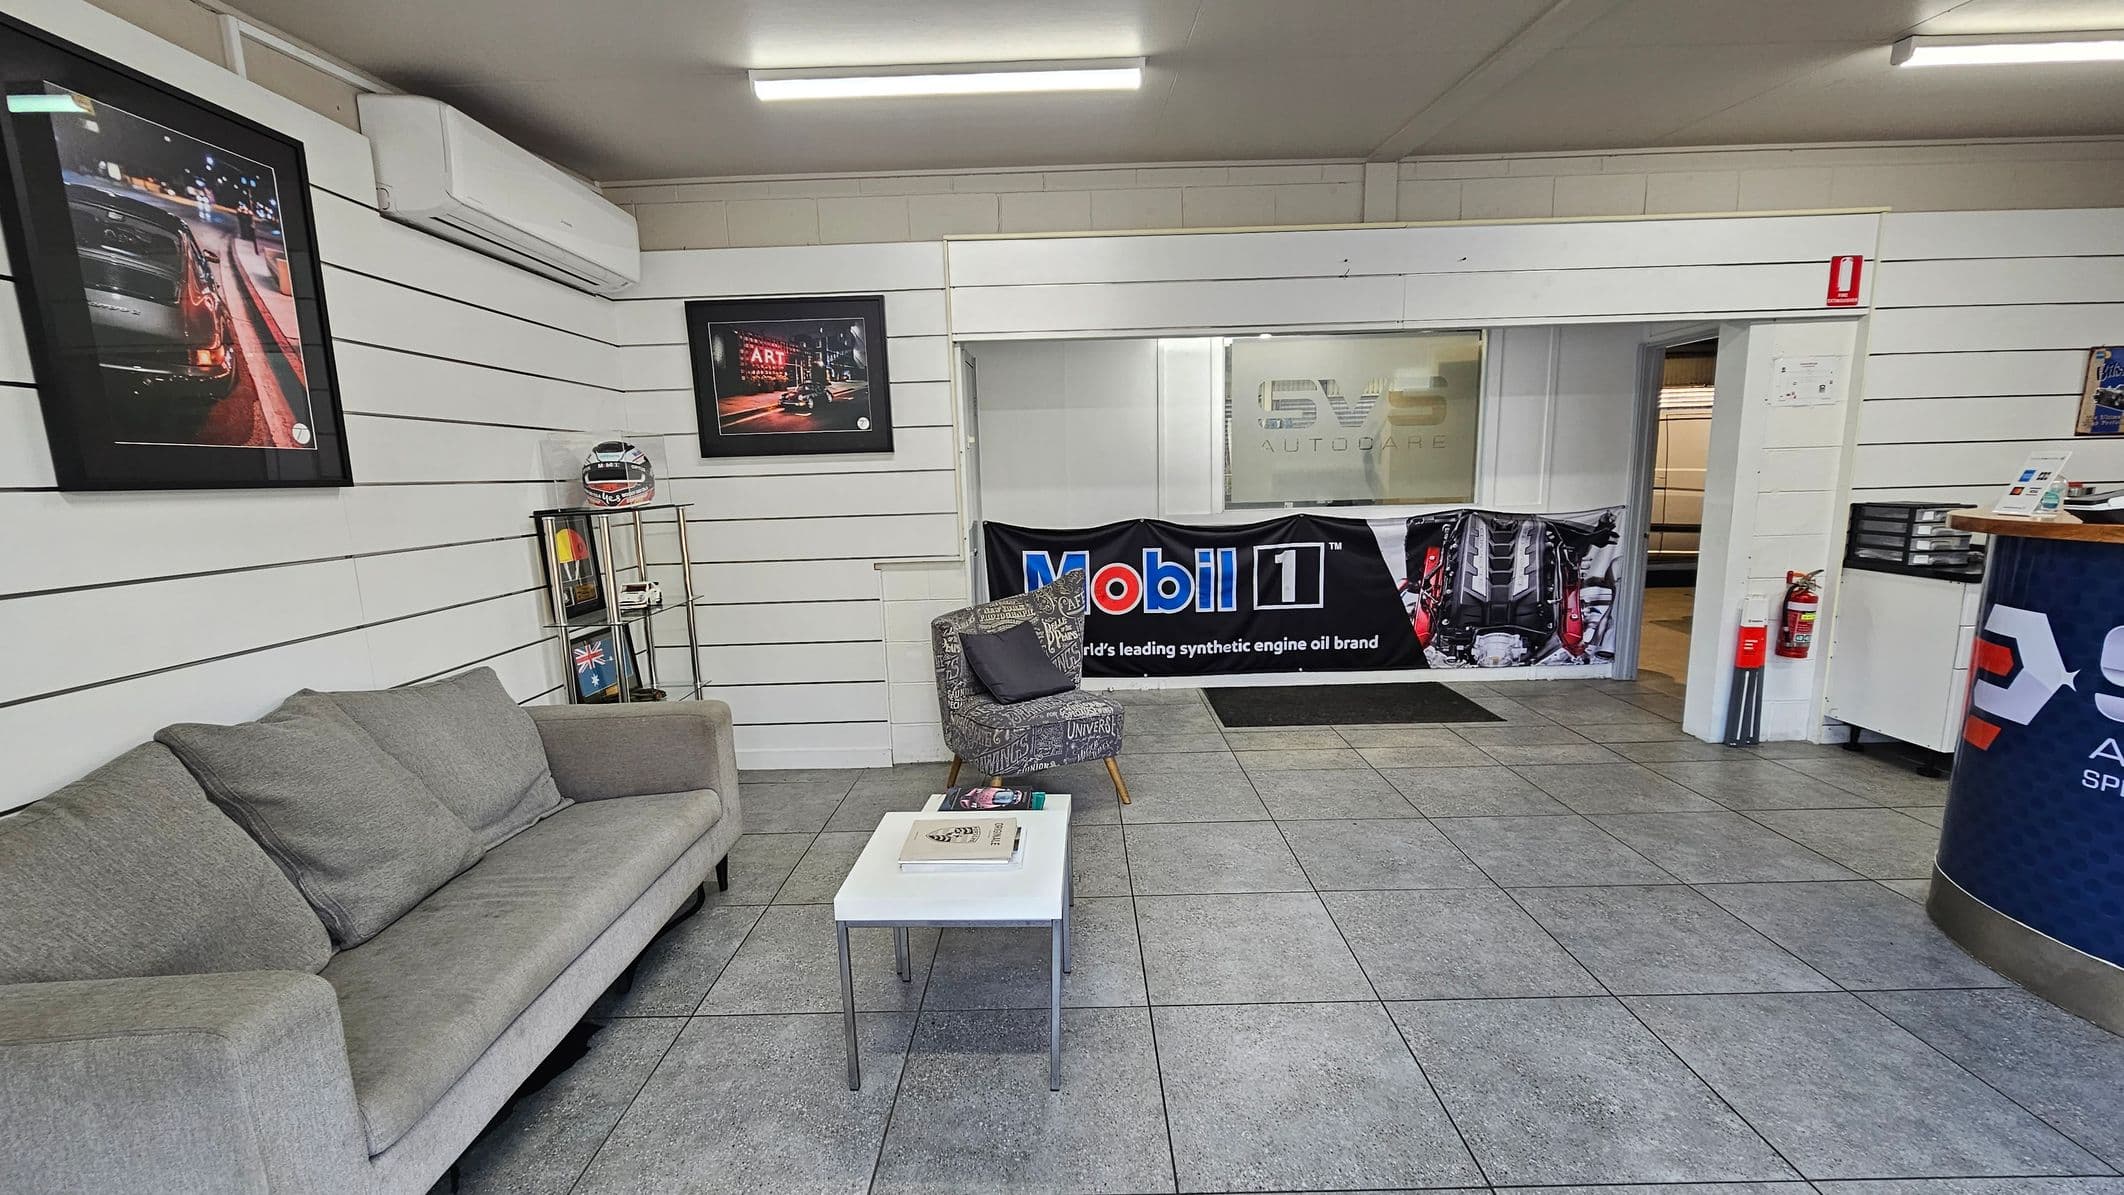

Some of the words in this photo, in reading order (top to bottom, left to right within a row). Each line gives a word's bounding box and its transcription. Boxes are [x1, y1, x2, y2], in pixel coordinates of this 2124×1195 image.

[751, 346, 785, 365] ART
[1258, 376, 1449, 430] SVS
[1260, 434, 1448, 454] AUTOCARE
[1083, 642, 1116, 657] rld's
[1119, 641, 1176, 659] leading
[1179, 638, 1251, 659] synthetic
[1254, 636, 1307, 655] engine
[1310, 635, 1330, 651] oil
[1334, 634, 1379, 650] brand
